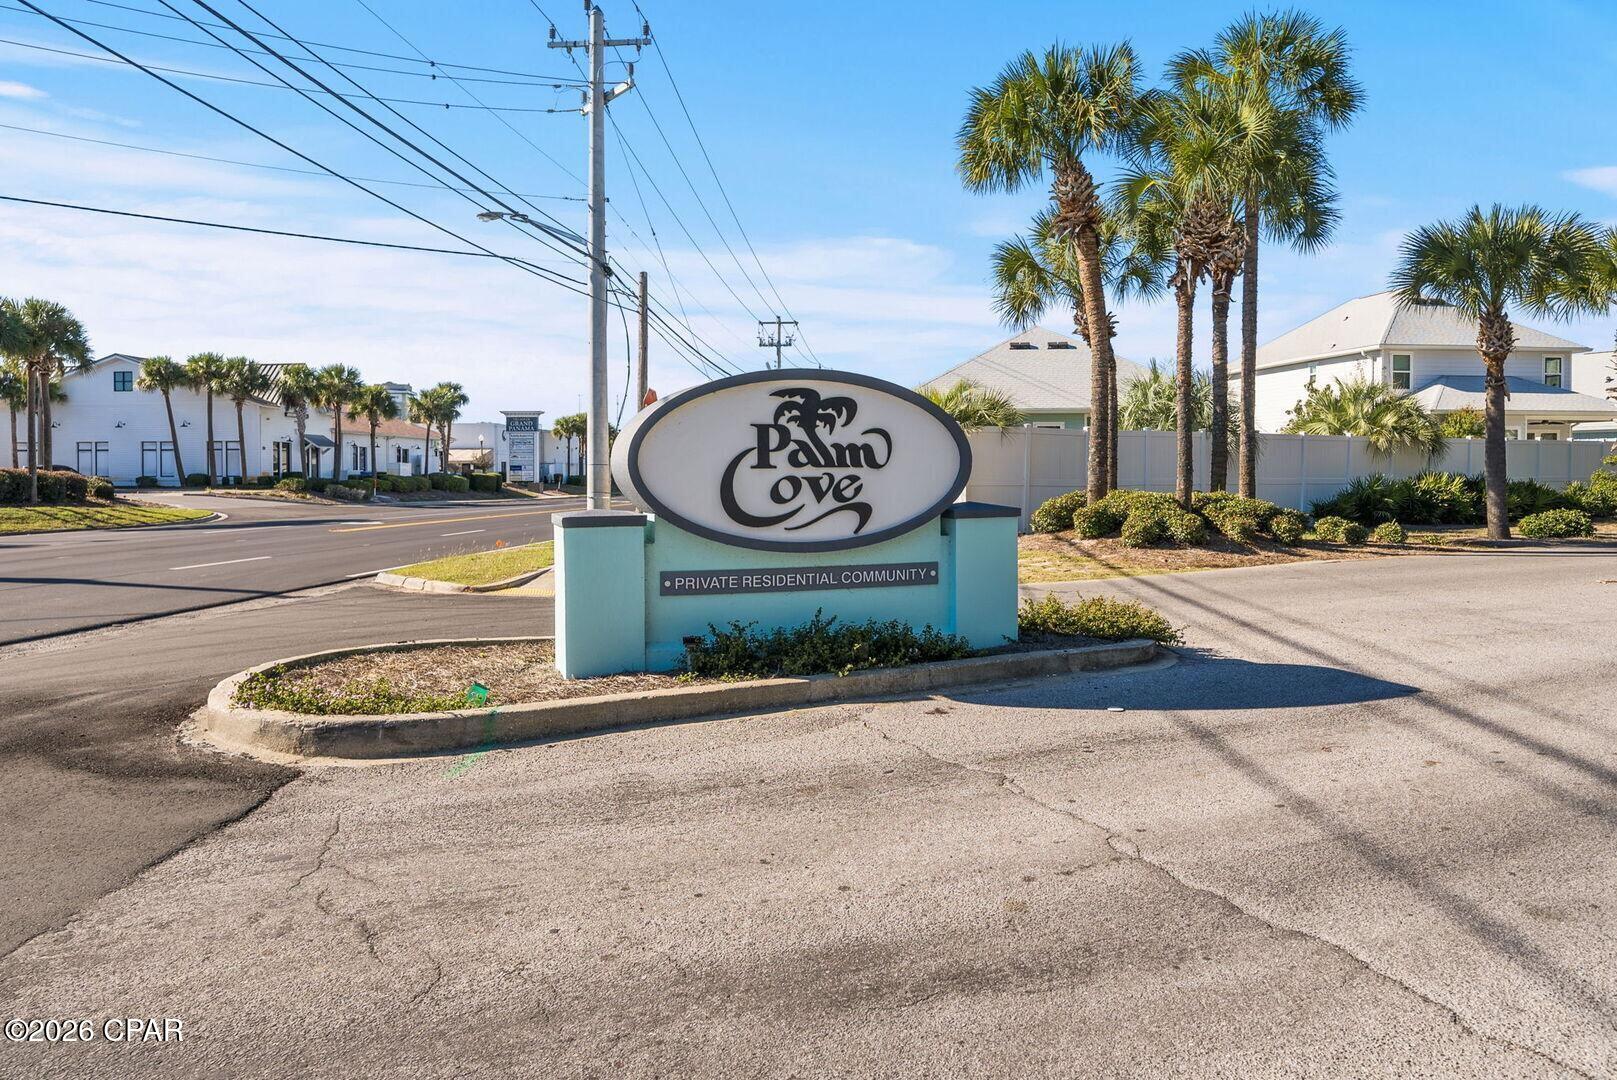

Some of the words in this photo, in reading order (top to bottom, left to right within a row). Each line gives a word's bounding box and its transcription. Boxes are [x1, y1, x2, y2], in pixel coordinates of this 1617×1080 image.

[750, 388, 892, 469] Palm
[720, 447, 864, 528] Cove
[675, 576, 739, 590] PRIVATE
[742, 572, 838, 588] RESIDENTIAL
[841, 568, 927, 584] COMMUNITY
